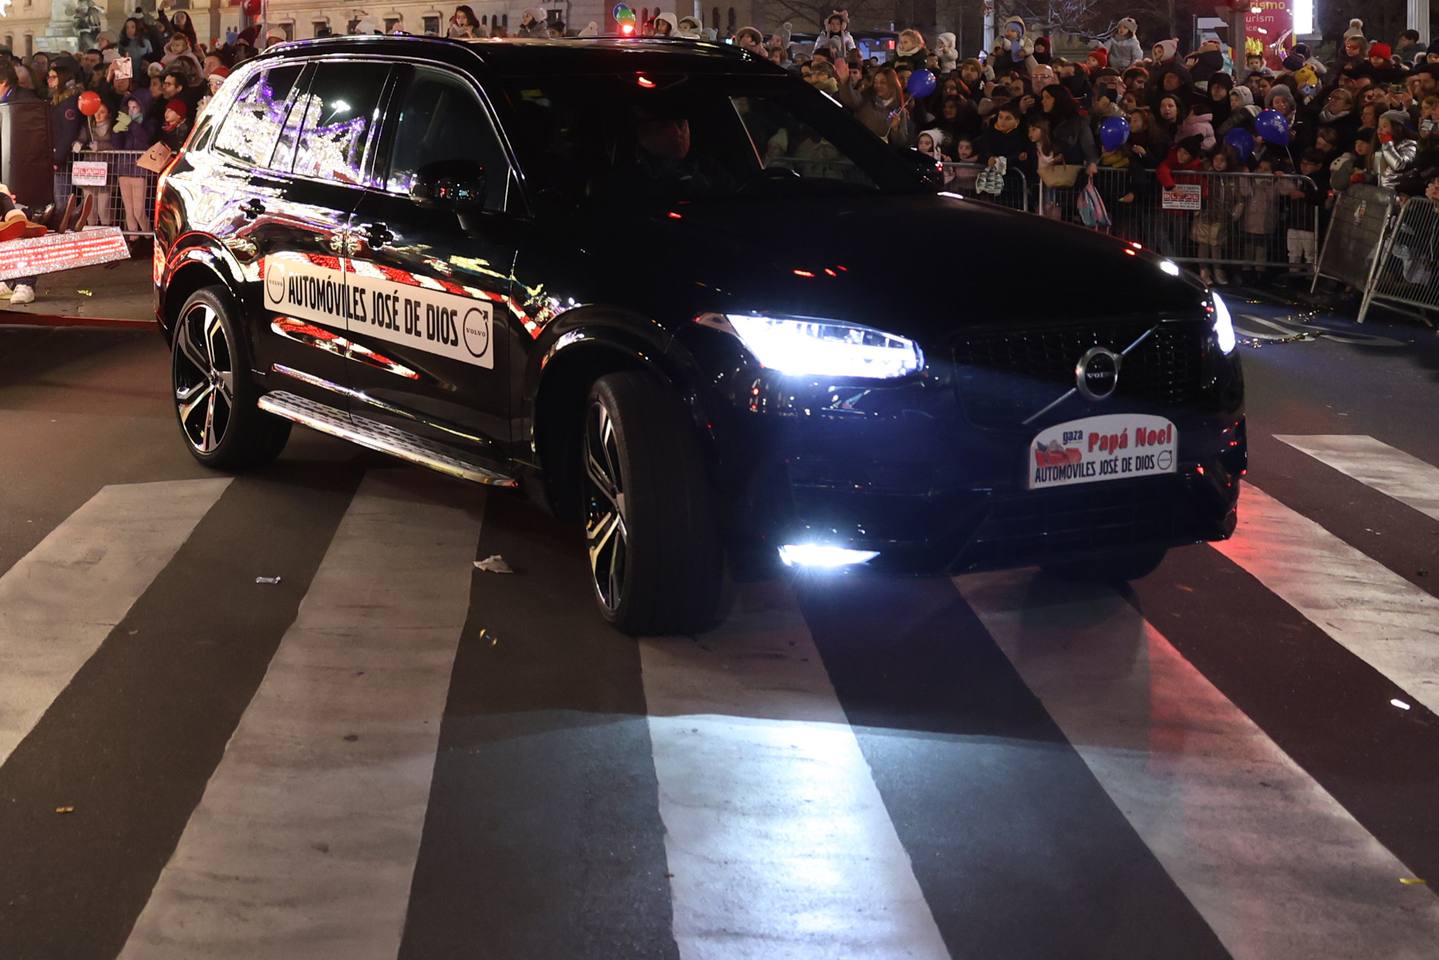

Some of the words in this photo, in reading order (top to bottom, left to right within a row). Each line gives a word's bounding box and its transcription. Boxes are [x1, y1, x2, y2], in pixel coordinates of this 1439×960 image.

[1250, 0, 1285, 10] rismo
[1246, 14, 1274, 22] urism
[288, 274, 367, 323] AUTOMÓVILES
[371, 289, 401, 332] JOSÉ
[404, 298, 422, 338] DE
[426, 303, 459, 347] DIOS
[465, 327, 486, 337] VOLVO
[1062, 430, 1083, 445] gaza
[1088, 428, 1128, 455] Papá
[1135, 423, 1172, 448] Noel
[1099, 455, 1118, 476] JOSÉ
[1121, 457, 1133, 473] DE
[1135, 454, 1155, 471] DIOS
